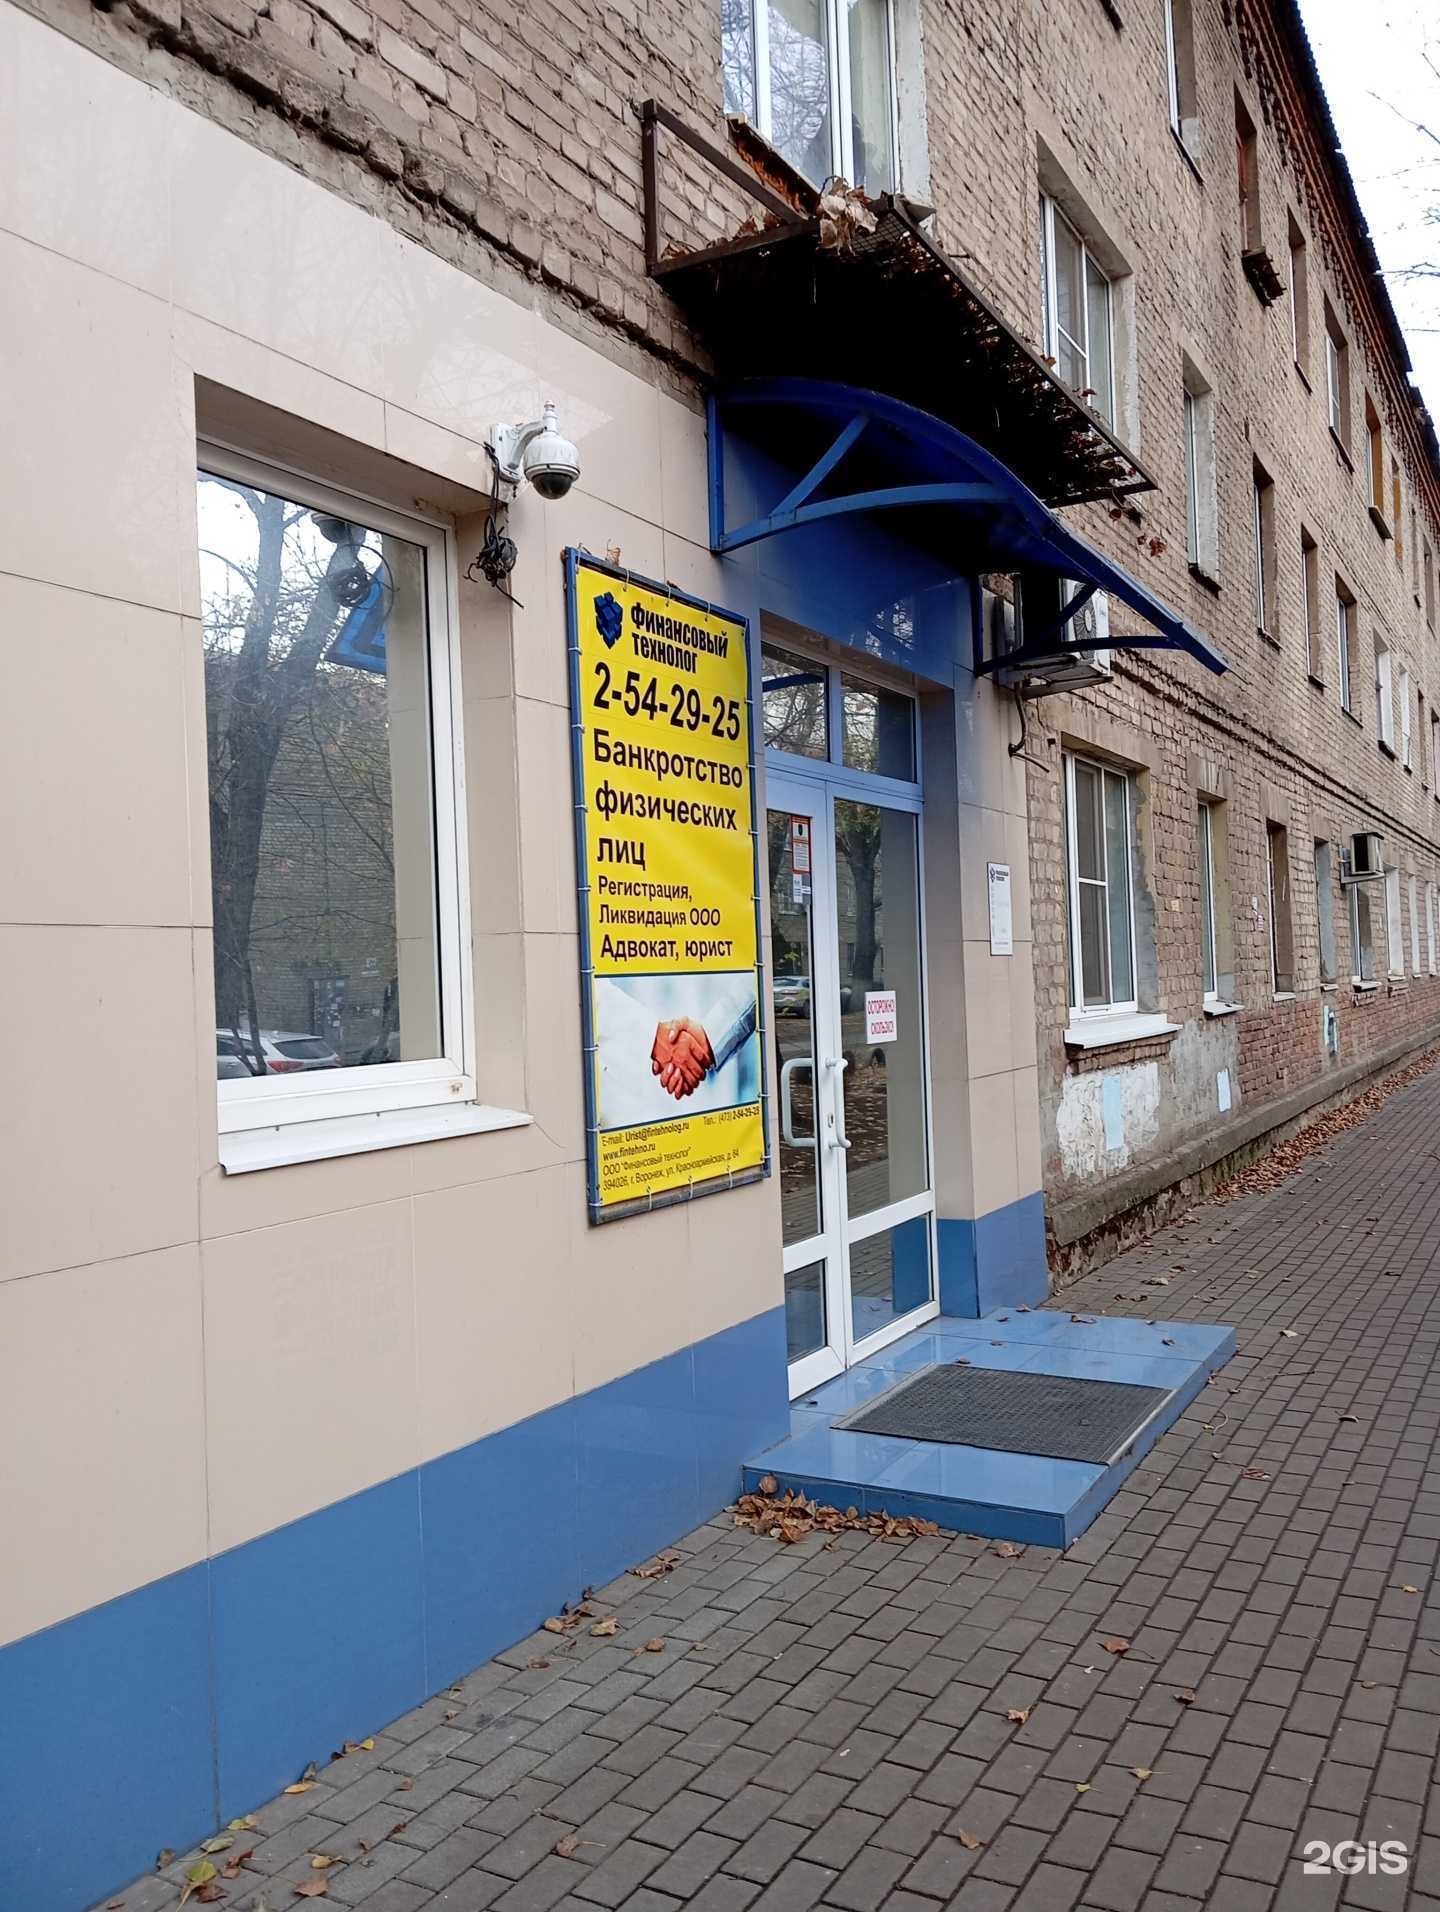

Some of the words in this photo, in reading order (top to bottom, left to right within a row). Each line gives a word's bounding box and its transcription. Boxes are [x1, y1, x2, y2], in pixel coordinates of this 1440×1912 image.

[631, 602, 728, 659] Финансовый
[632, 632, 698, 674] технолог
[593, 661, 740, 741] 2-54-29-25
[593, 728, 743, 788] Банкротство
[595, 780, 737, 830] физических
[597, 837, 645, 871] лиц
[598, 875, 692, 902] Регистрация,
[599, 904, 686, 928] Ликвидация
[689, 908, 721, 926] ООО
[601, 934, 679, 962] Адвокат,
[685, 940, 733, 962] юрист
